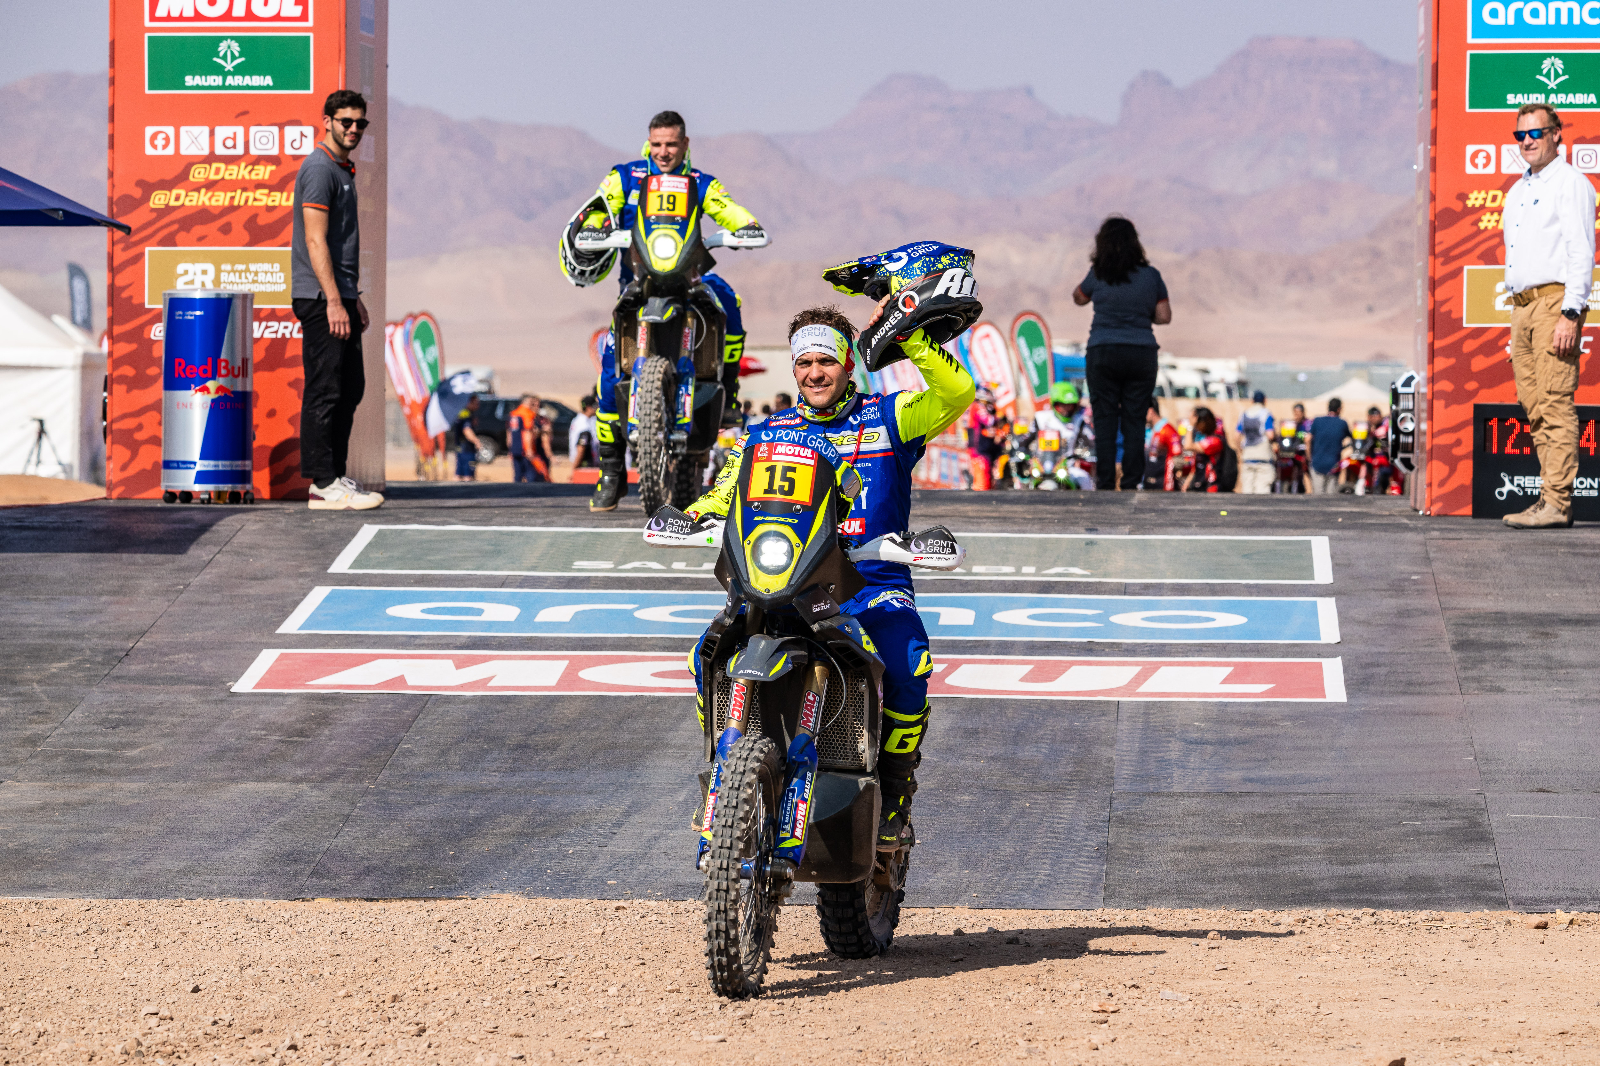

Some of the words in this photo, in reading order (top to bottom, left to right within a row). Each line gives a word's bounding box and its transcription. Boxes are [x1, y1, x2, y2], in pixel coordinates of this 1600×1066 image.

[185, 75, 222, 86] SAUDI
[225, 75, 273, 86] ARABIA
[1506, 93, 1545, 104] SAUDI
[1547, 93, 1597, 104] ARABIA
[189, 162, 275, 182] @Dakar
[657, 194, 676, 212] 19
[176, 263, 215, 290] 2R
[248, 263, 280, 271] WORLD
[220, 272, 285, 283] RALLY-RAID
[220, 283, 287, 292] CHAMPIONSHIP
[174, 357, 213, 378] Red
[216, 358, 249, 378] Bull
[775, 429, 807, 443] PONT
[807, 435, 837, 460] GRUP
[775, 445, 813, 457] MOTUL
[763, 465, 797, 496] 15
[665, 524, 691, 534] GRUP
[667, 518, 693, 528] PONT
[927, 546, 952, 554] GRUP
[928, 539, 954, 548] PONT
[731, 683, 747, 721] MAC
[801, 691, 817, 729] MAC
[703, 795, 715, 831] MOTUL
[794, 802, 807, 840] MOTUL
